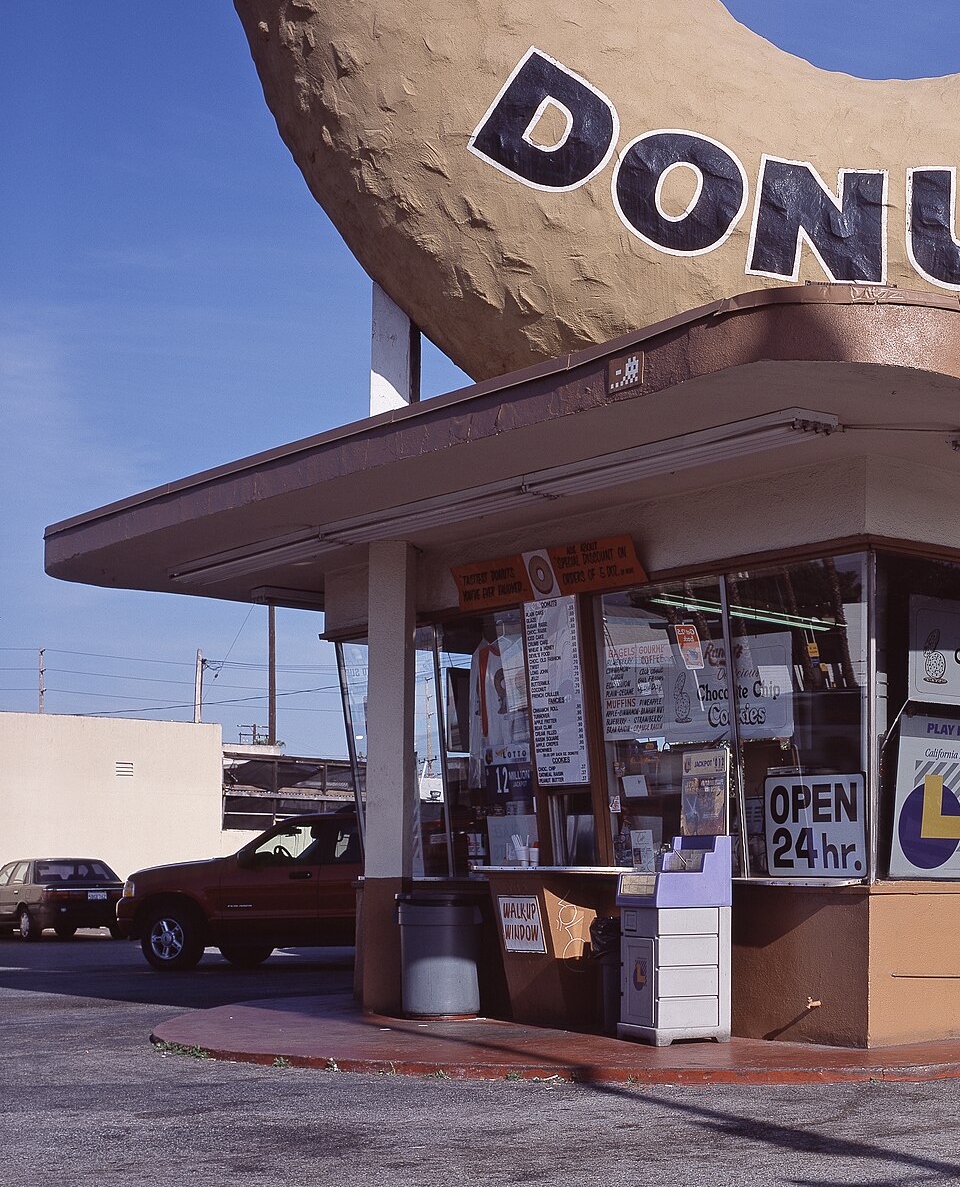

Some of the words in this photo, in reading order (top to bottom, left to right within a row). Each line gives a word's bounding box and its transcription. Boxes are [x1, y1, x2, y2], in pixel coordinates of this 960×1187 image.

[618, 545, 626, 558] ON
[588, 568, 596, 580] OF
[541, 600, 557, 608] DONUTS
[609, 647, 635, 659] BAGELS
[753, 680, 782, 700] Chip
[607, 699, 636, 709] MUFFINS
[927, 723, 956, 736] PLAY
[503, 750, 526, 758] LOTTO
[925, 748, 959, 760] California
[496, 766, 509, 793] 12
[509, 770, 530, 780] MILLION
[770, 782, 858, 824] OPEN
[772, 827, 818, 869] 24
[822, 832, 862, 871] hr.
[505, 924, 539, 942] WINDOW
